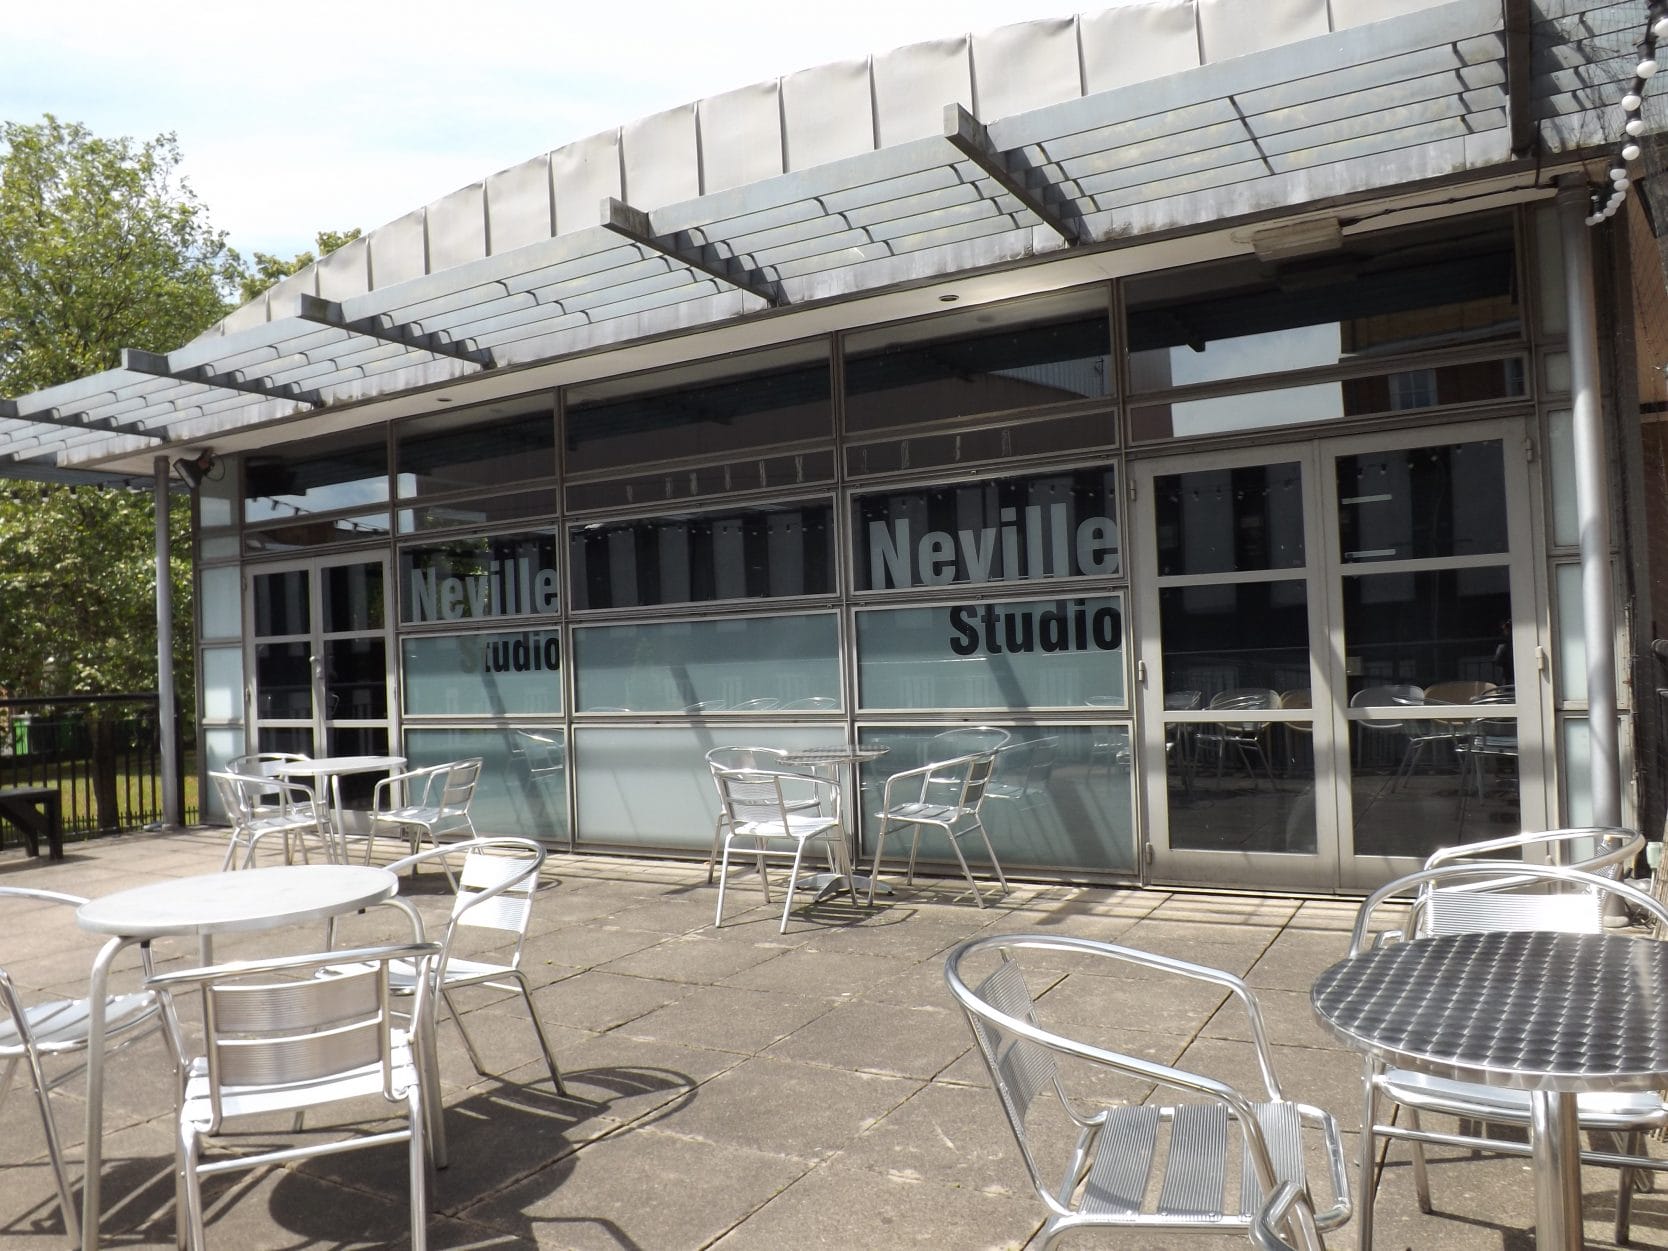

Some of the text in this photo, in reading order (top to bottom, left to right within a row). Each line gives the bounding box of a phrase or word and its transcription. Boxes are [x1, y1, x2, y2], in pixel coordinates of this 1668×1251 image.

[868, 502, 1120, 590] Neville
[411, 557, 559, 623] Neville
[950, 599, 1122, 656] Studio
